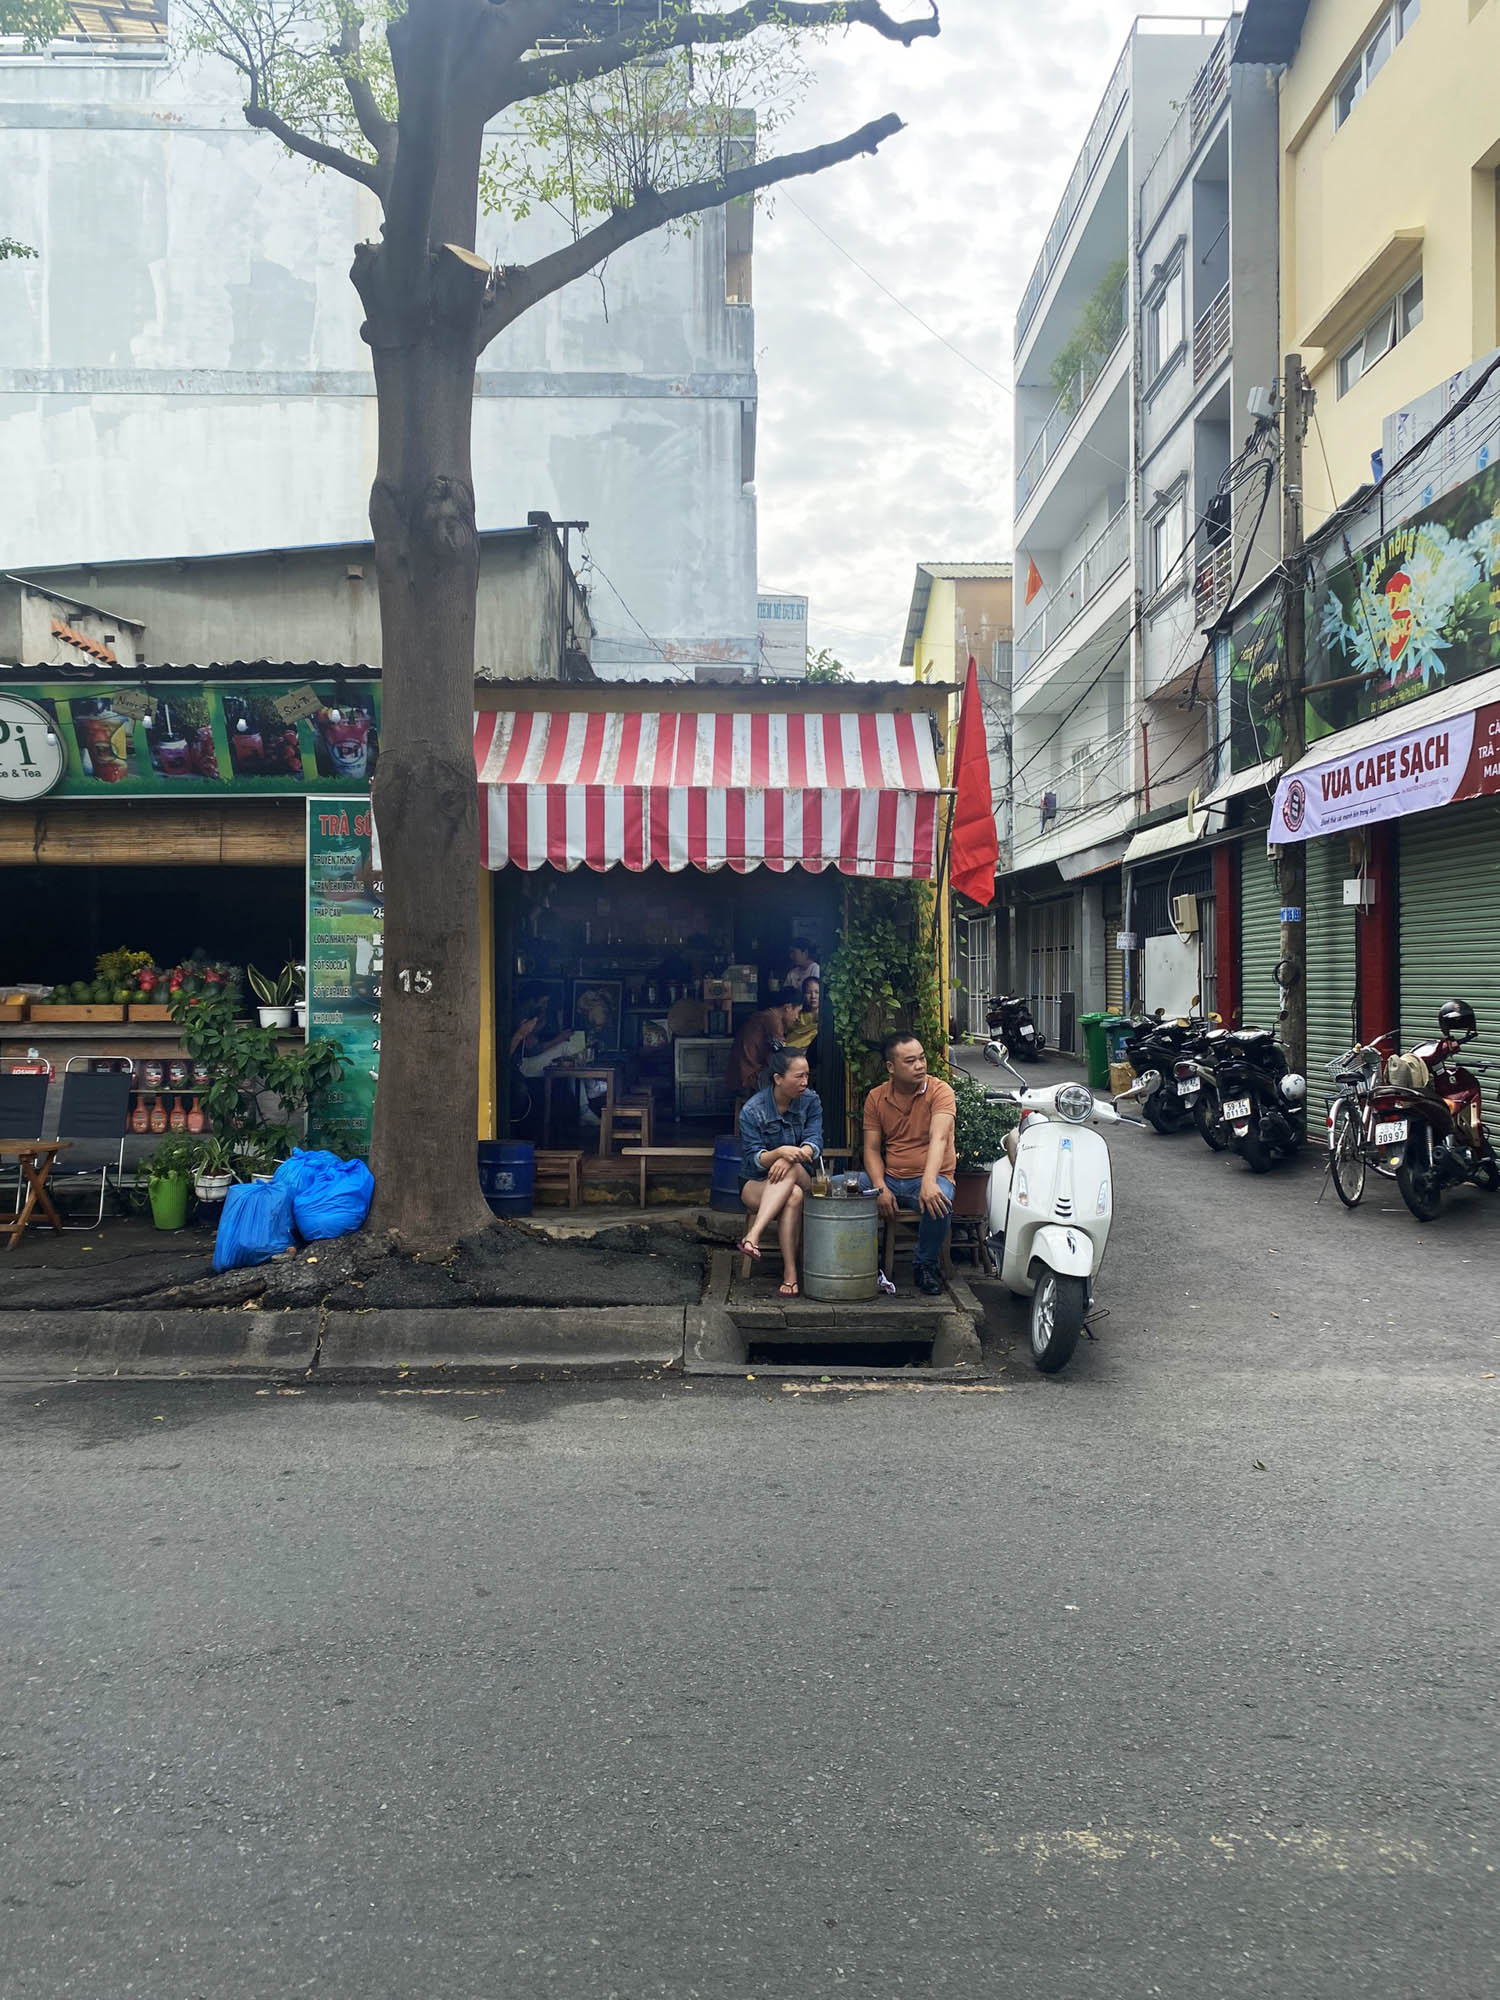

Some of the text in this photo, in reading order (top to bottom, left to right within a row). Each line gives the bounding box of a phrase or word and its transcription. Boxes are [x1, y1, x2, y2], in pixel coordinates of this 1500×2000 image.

[1478, 741, 1494, 759] TRÀ
[12, 769, 20, 778] &
[22, 769, 42, 778] Tea
[1321, 766, 1352, 801] VUA
[1355, 750, 1396, 791] CAFE
[1399, 732, 1449, 783] SẠCH
[318, 809, 350, 836] TRÀ
[399, 970, 432, 993] 15
